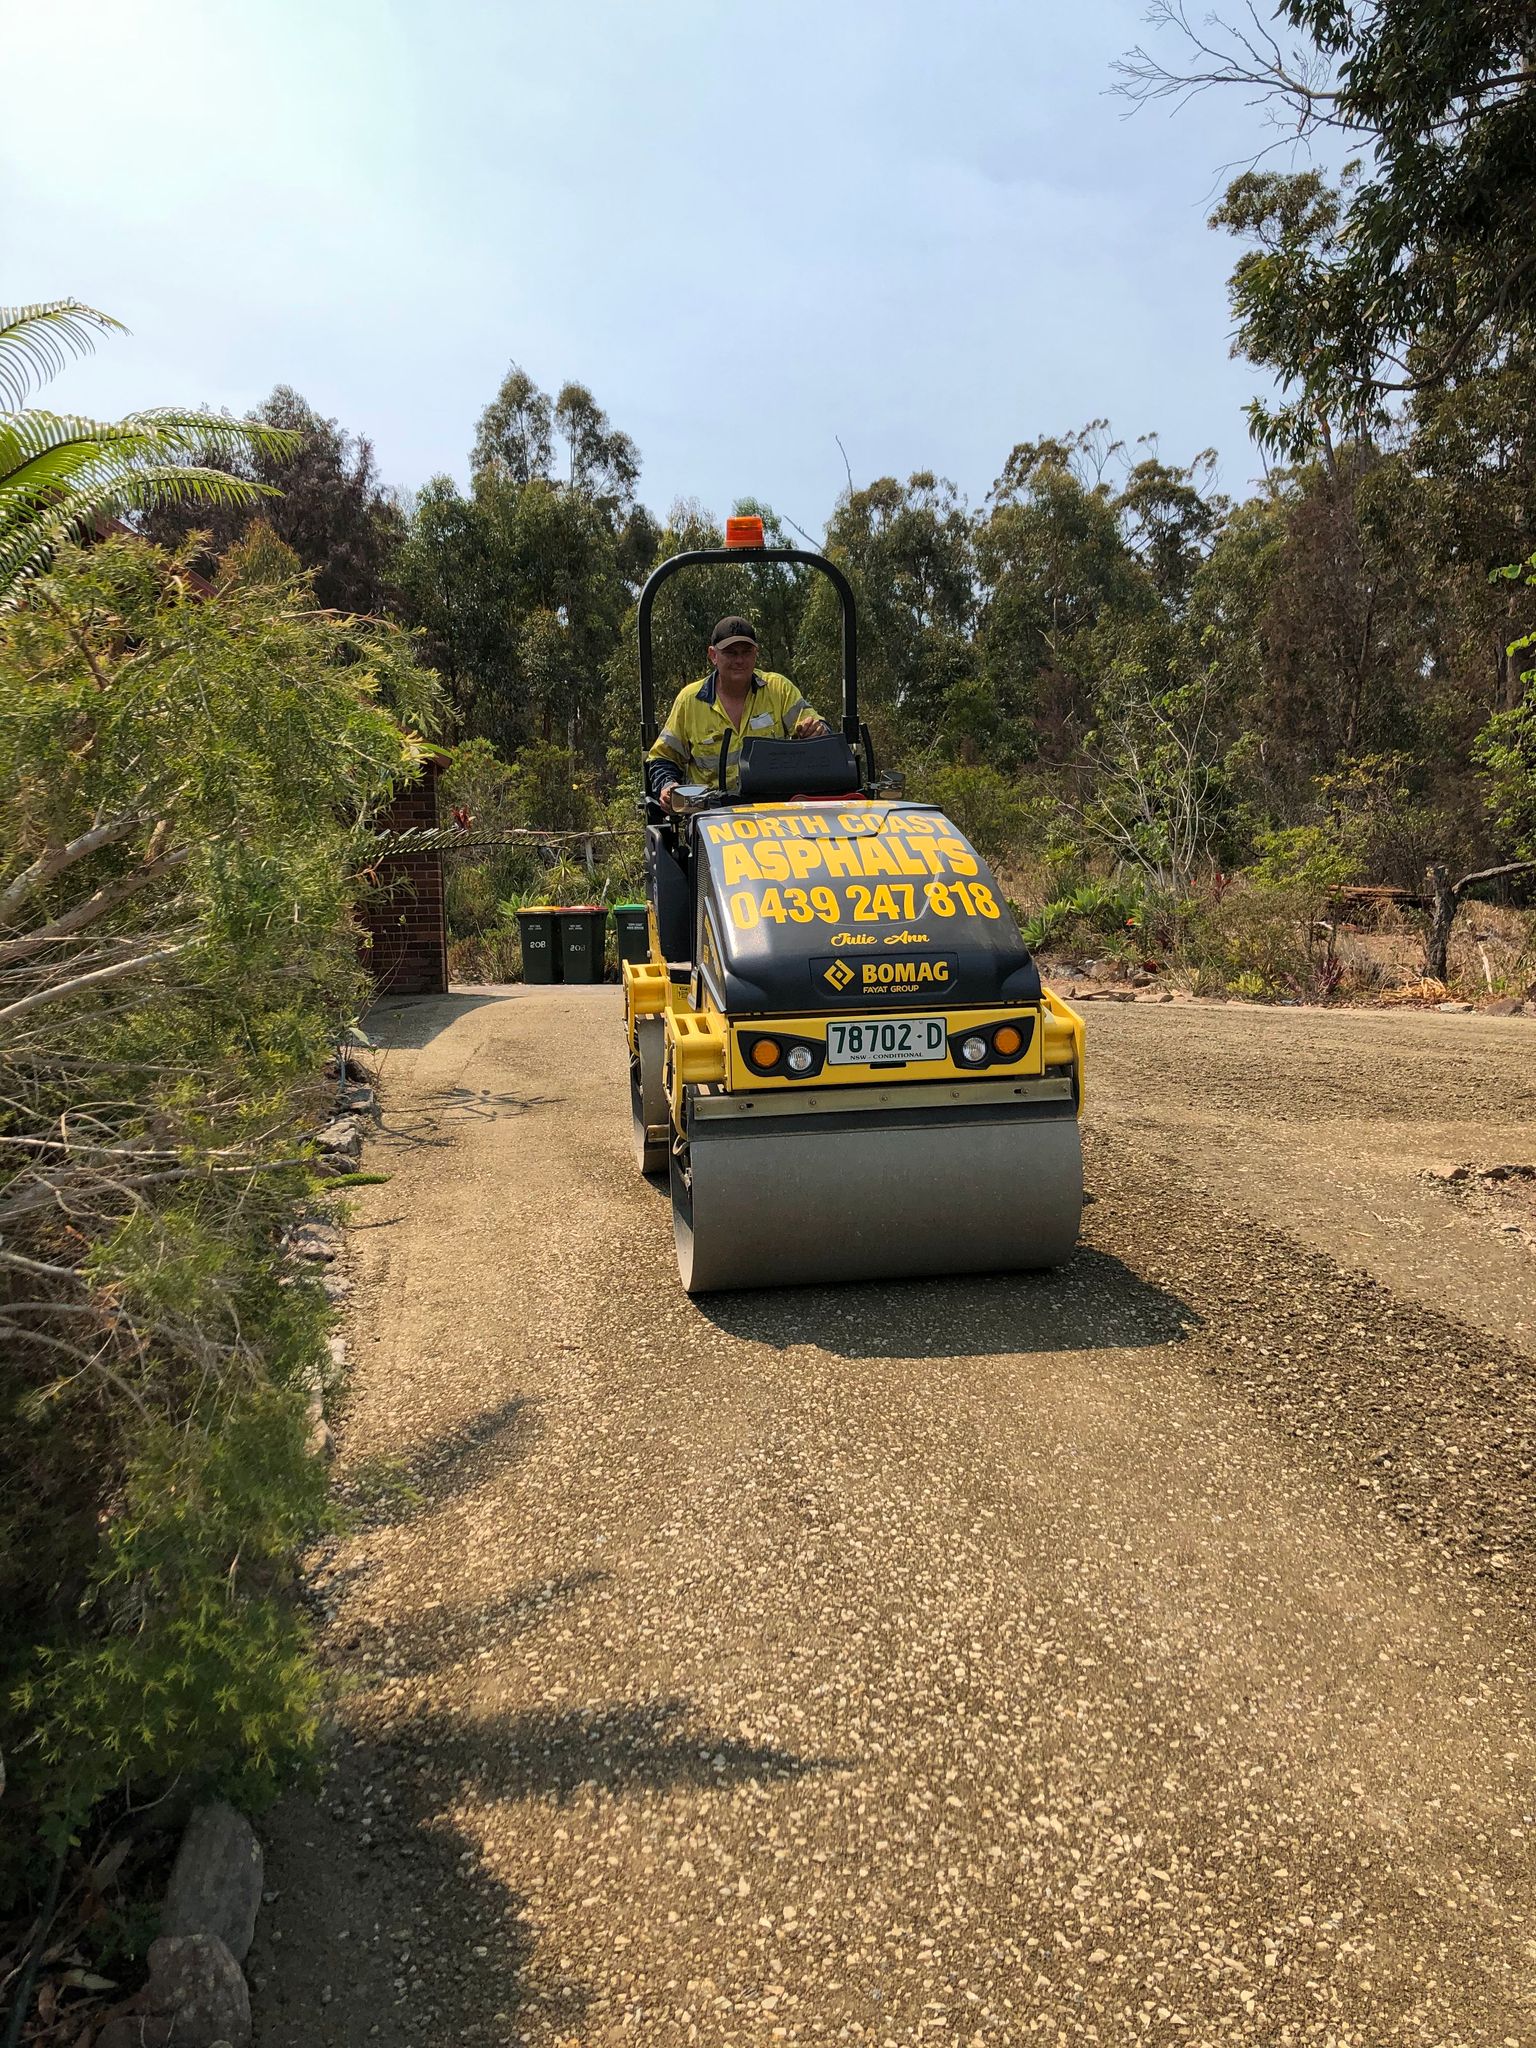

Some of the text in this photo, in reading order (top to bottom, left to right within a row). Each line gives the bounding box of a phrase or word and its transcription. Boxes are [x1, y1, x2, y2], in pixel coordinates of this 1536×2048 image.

[707, 813, 950, 844] NORTH COAST
[722, 836, 978, 886] ASPHALTS
[729, 881, 1001, 930] 0439 247 818
[830, 930, 930, 947] Julie Ann
[862, 961, 949, 984] BOMAG
[863, 984, 920, 994] FAYAT GROUP
[872, 1052, 924, 1060] CONDITIONAL
